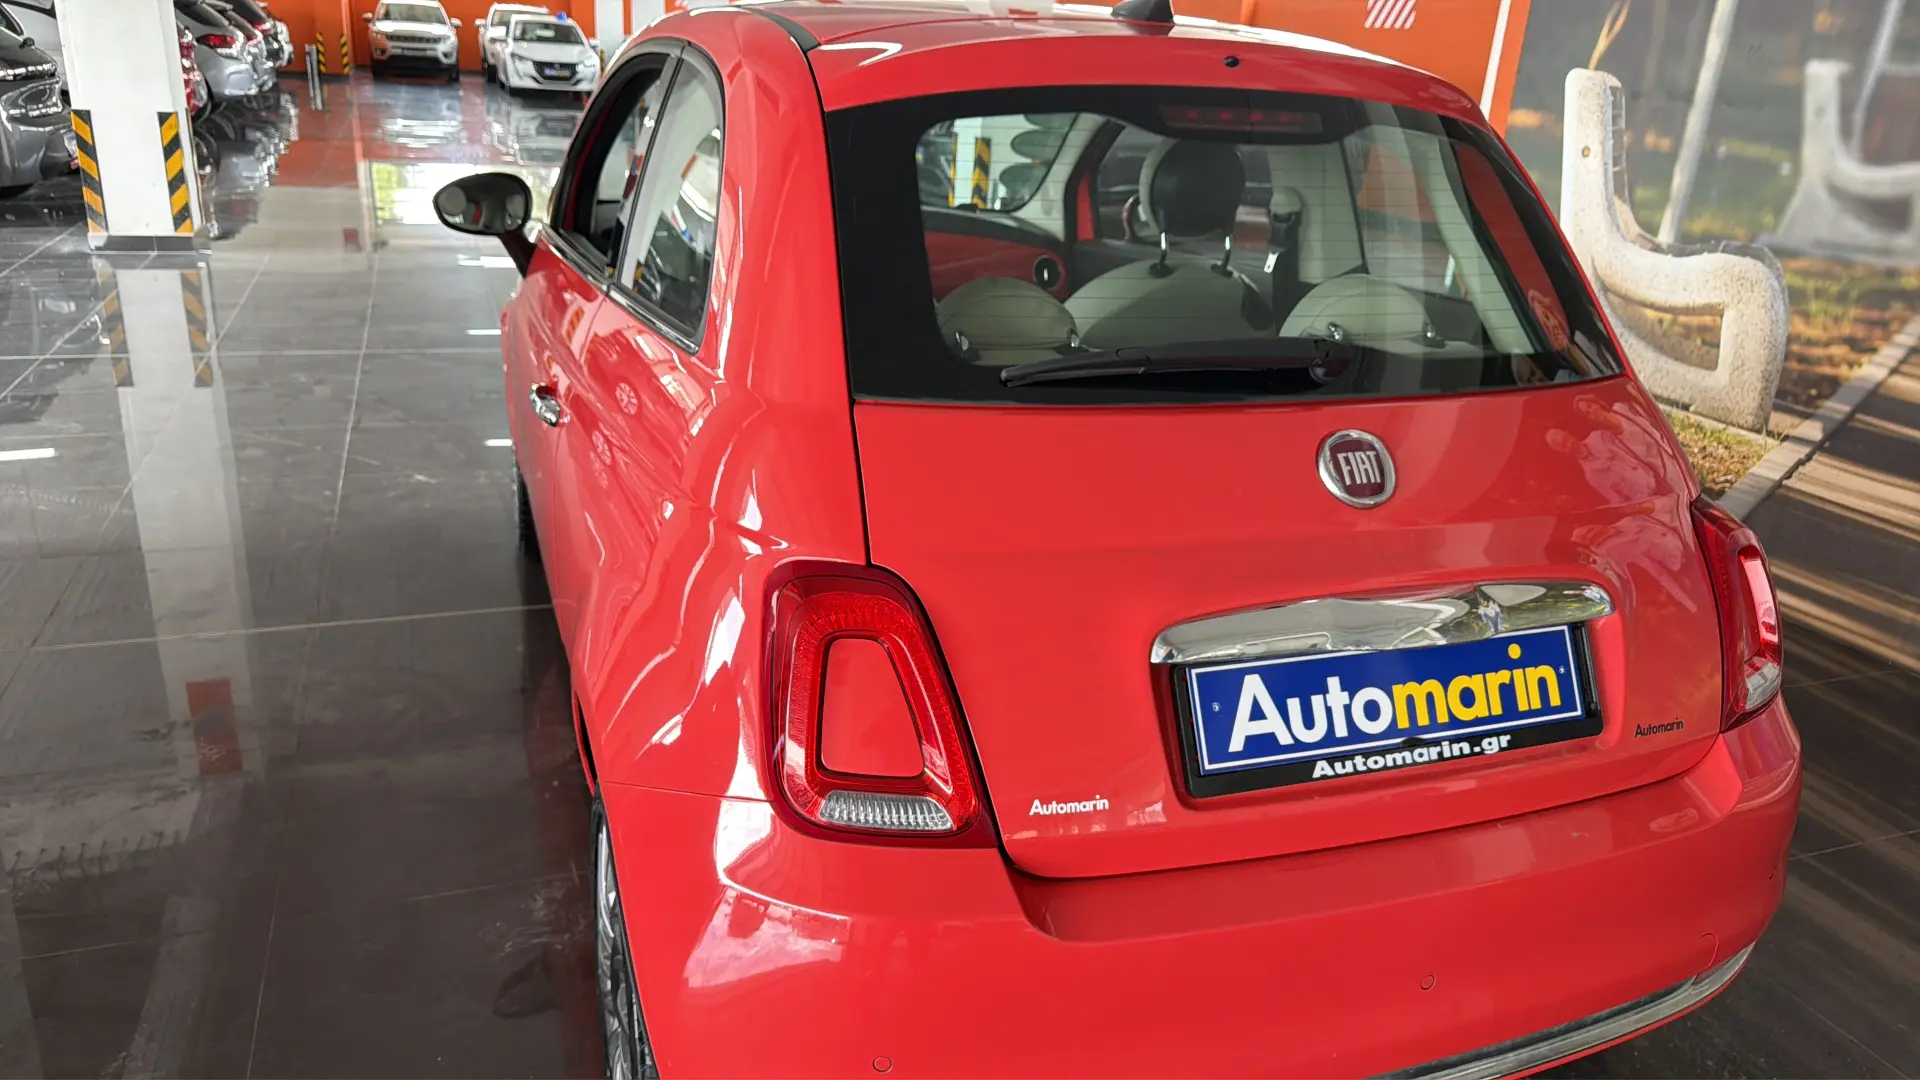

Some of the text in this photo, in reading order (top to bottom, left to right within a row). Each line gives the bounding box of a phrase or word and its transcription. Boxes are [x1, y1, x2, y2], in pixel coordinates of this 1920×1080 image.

[1337, 451, 1381, 485] FIAT
[1228, 643, 1561, 752] Automarin
[1634, 717, 1684, 739] Automarin
[1312, 733, 1511, 778] Automarin.gr
[1028, 794, 1109, 816] Automarin
